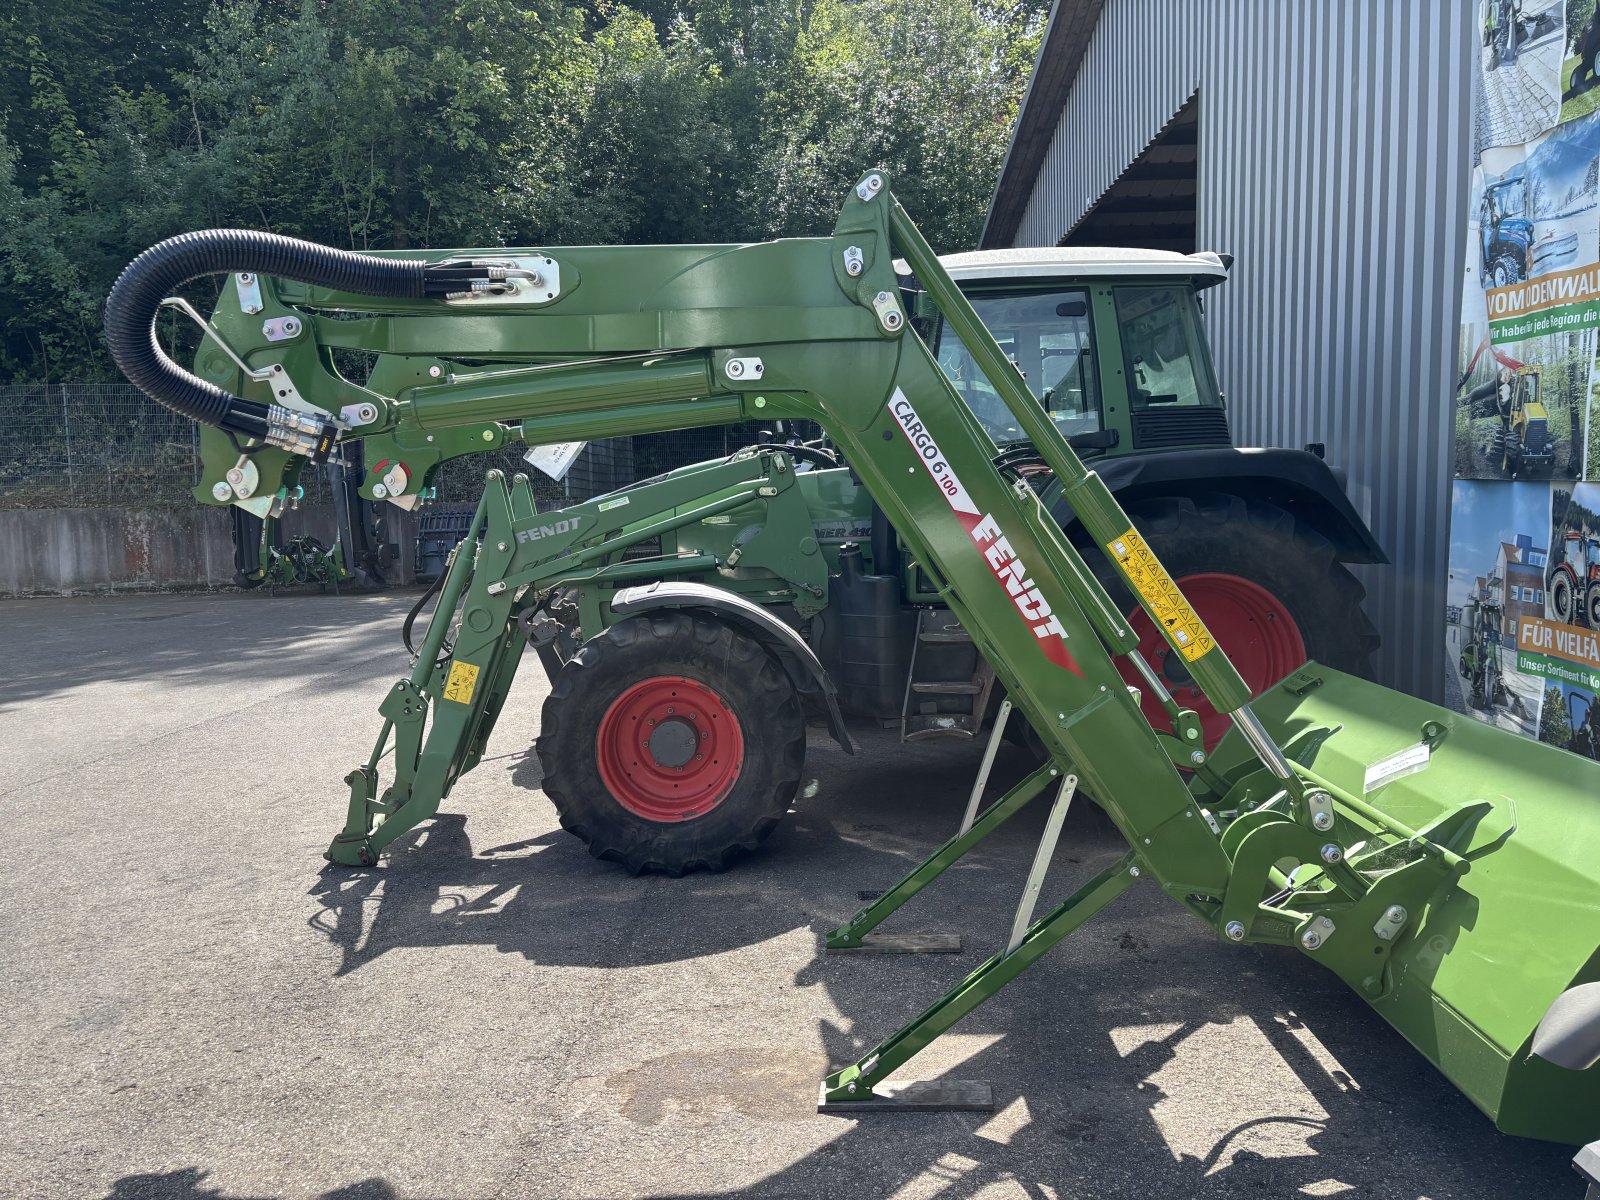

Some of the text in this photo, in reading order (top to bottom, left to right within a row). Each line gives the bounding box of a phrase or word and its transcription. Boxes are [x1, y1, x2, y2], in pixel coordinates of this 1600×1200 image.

[1487, 288, 1525, 315] VOM
[1533, 319, 1550, 333] jede
[1550, 312, 1580, 328] Region
[1583, 309, 1597, 322] die
[894, 400, 958, 496] CARGO 6 100
[515, 516, 582, 544] FENDT
[971, 512, 1069, 639] FENDT
[1522, 620, 1552, 649] FÜR
[1520, 656, 1546, 672] Unser
[1547, 662, 1579, 683] Sortiment
[1580, 671, 1590, 685] für
